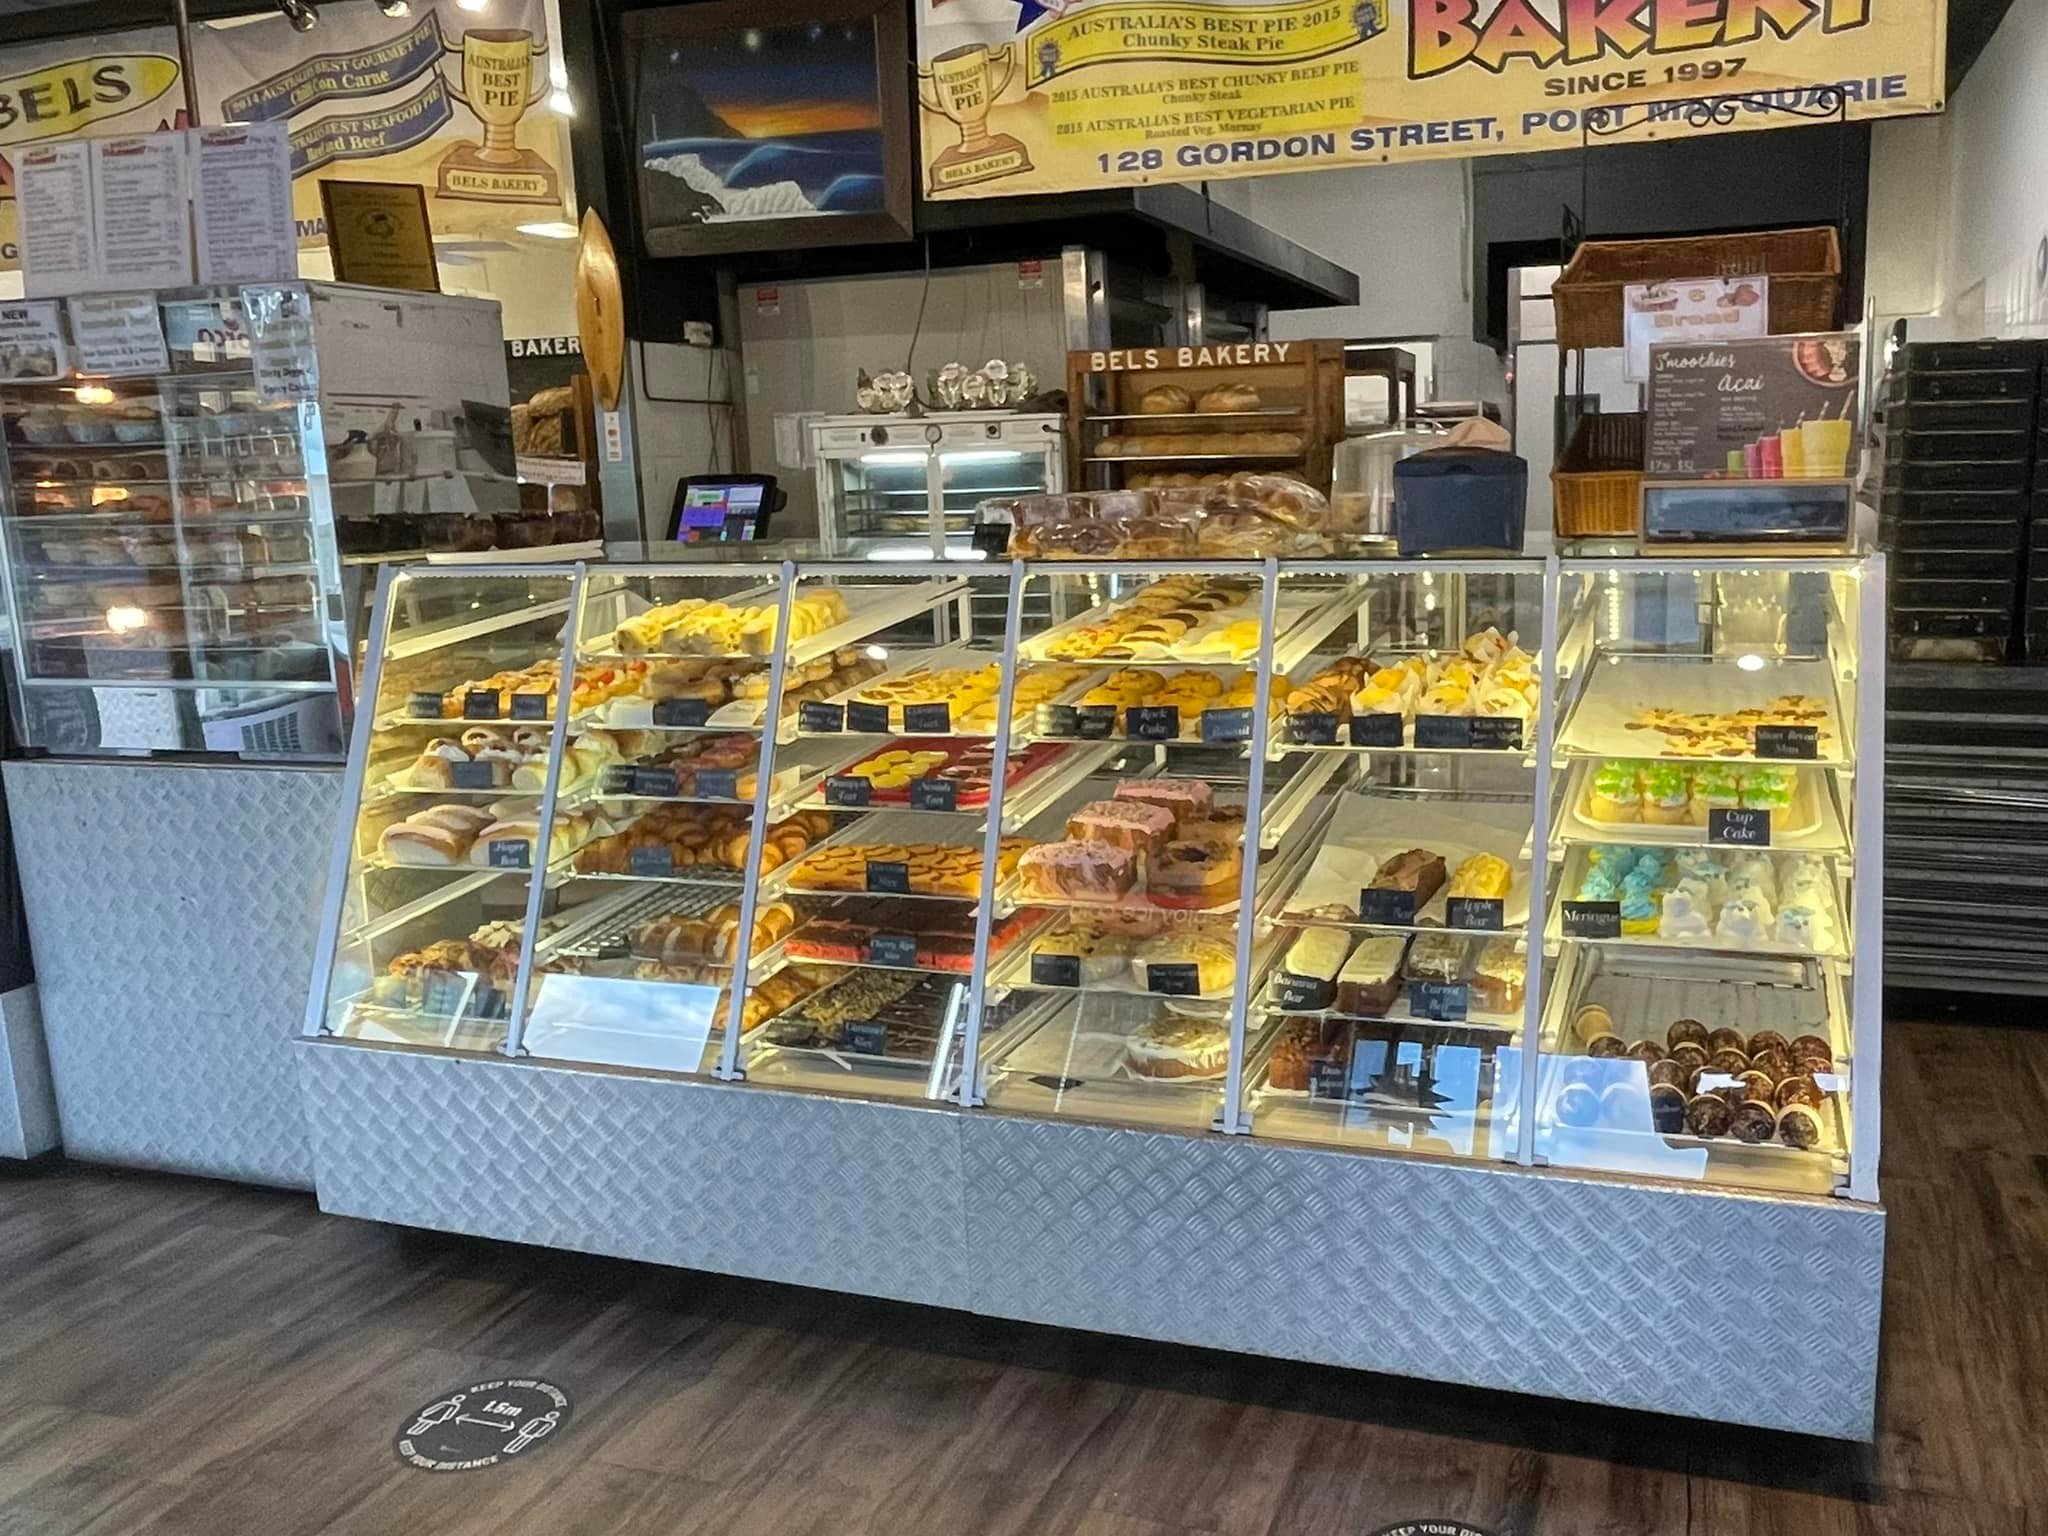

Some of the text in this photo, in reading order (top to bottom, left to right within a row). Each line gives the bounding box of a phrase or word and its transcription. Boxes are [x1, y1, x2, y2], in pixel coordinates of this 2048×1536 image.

[1067, 6, 1342, 41] AUSTRALIA'S BEST PIE 2015
[1123, 33, 1285, 51] Chunky Steak Pie
[352, 41, 414, 69] GOURMET
[342, 70, 391, 88] Carne
[482, 72, 521, 87] BEST
[1080, 79, 1175, 100] AUSTRALIA'S
[1178, 76, 1219, 92] BEST
[1222, 71, 1288, 88] CHUNKY
[1291, 65, 1331, 81] BEEF
[1333, 60, 1360, 76] PIE
[1544, 57, 1747, 97] SINCE 1997
[950, 77, 981, 96] BEST
[484, 90, 519, 107] PIE
[955, 91, 984, 111] PIE
[1162, 89, 1242, 105] Chunky Steak
[363, 102, 423, 130] SEAFOOD
[1086, 113, 1181, 133] AUSTRALIA'S
[1184, 109, 1223, 125] BEST
[1226, 99, 1326, 122] VEGETARIAN
[1329, 96, 1356, 110] PIE
[349, 131, 385, 149] Beef
[1098, 149, 1163, 174] 128
[1176, 132, 1336, 168] GORDON
[1350, 117, 1504, 152] STREET,
[1522, 104, 1630, 135] PORT
[1145, 127, 1190, 140] Roasted
[945, 155, 1016, 181] BELS BAKERY
[452, 175, 539, 191] BELS BAKERY
[511, 337, 581, 358] BAKER
[1091, 343, 1290, 372] BELS BAKERY
[1655, 352, 1738, 372] Smoothies
[1725, 810, 1755, 824] Cup
[1722, 825, 1756, 840] Cake
[1563, 908, 1620, 925] Meringue
[470, 1381, 505, 1394] KEEP
[508, 1379, 538, 1389] YOUR
[434, 1453, 500, 1470] DISTANCE
[1419, 1524, 1458, 1536] YOUR
